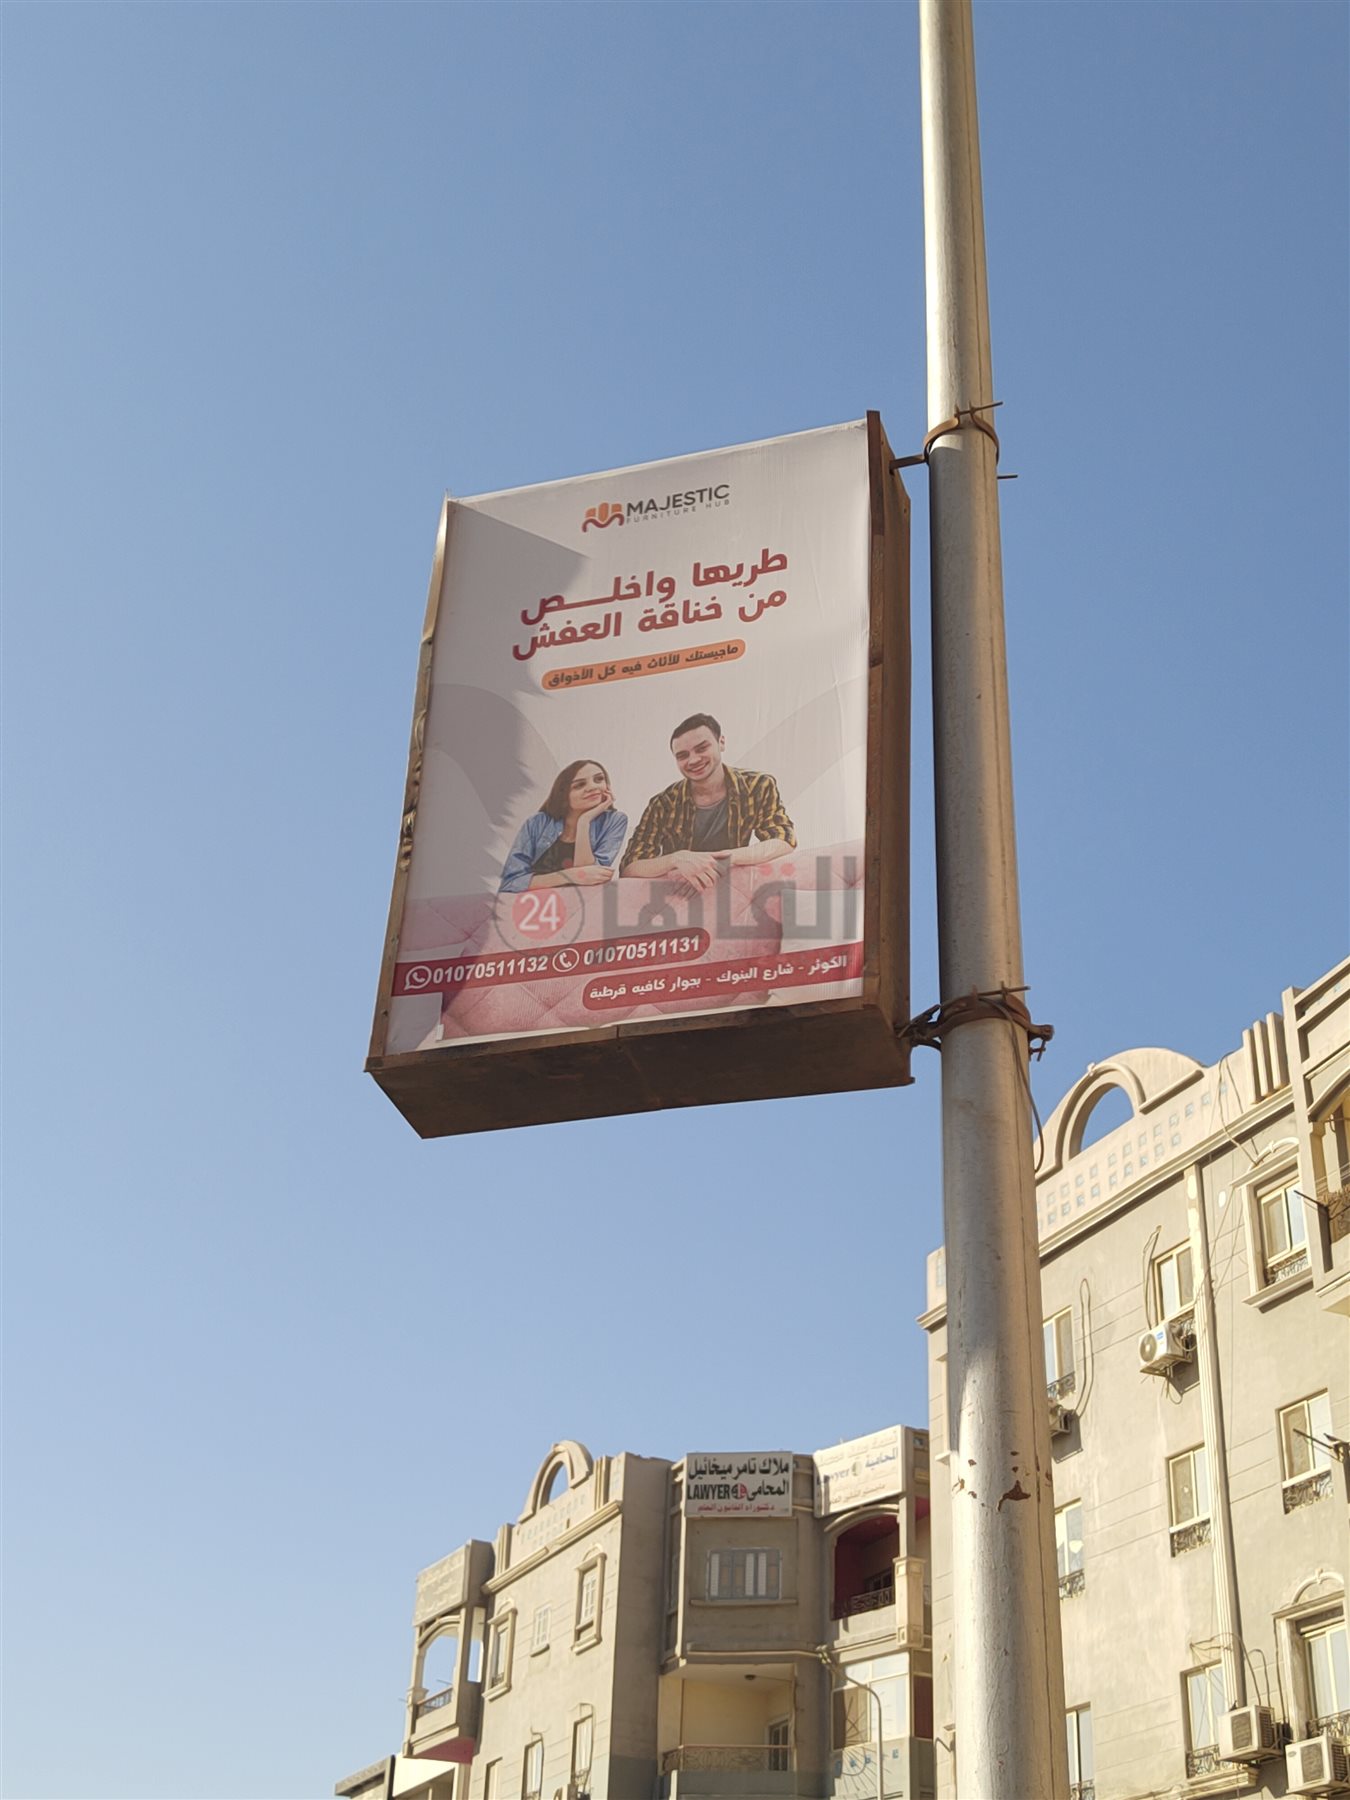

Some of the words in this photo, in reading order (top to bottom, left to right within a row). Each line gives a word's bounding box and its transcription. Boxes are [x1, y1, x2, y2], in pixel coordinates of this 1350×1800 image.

[627, 484, 730, 517] MAJESTIC
[626, 506, 696, 524] FURNITURE
[705, 499, 730, 509] HUB
[692, 548, 788, 587] طريها
[638, 596, 722, 633] خناقة
[738, 588, 788, 623] من
[512, 612, 622, 661] العفش
[685, 645, 739, 662] ماجيستك
[548, 668, 593, 687] الأذواق
[597, 665, 616, 680] كل
[621, 660, 642, 676] فيه
[583, 935, 700, 966] 01070511131
[432, 955, 548, 984] 01070511132
[716, 967, 757, 984] البنوك
[763, 965, 794, 981] شارع
[808, 955, 848, 976] الكوثر
[590, 984, 626, 1000] قرطبة
[632, 979, 666, 995] كافيه
[669, 977, 701, 992] بجوار
[688, 1456, 733, 1480] ميخائيل
[732, 1457, 757, 1480] تامر
[759, 1456, 790, 1476] ملاك
[687, 1484, 731, 1500] LAWYER
